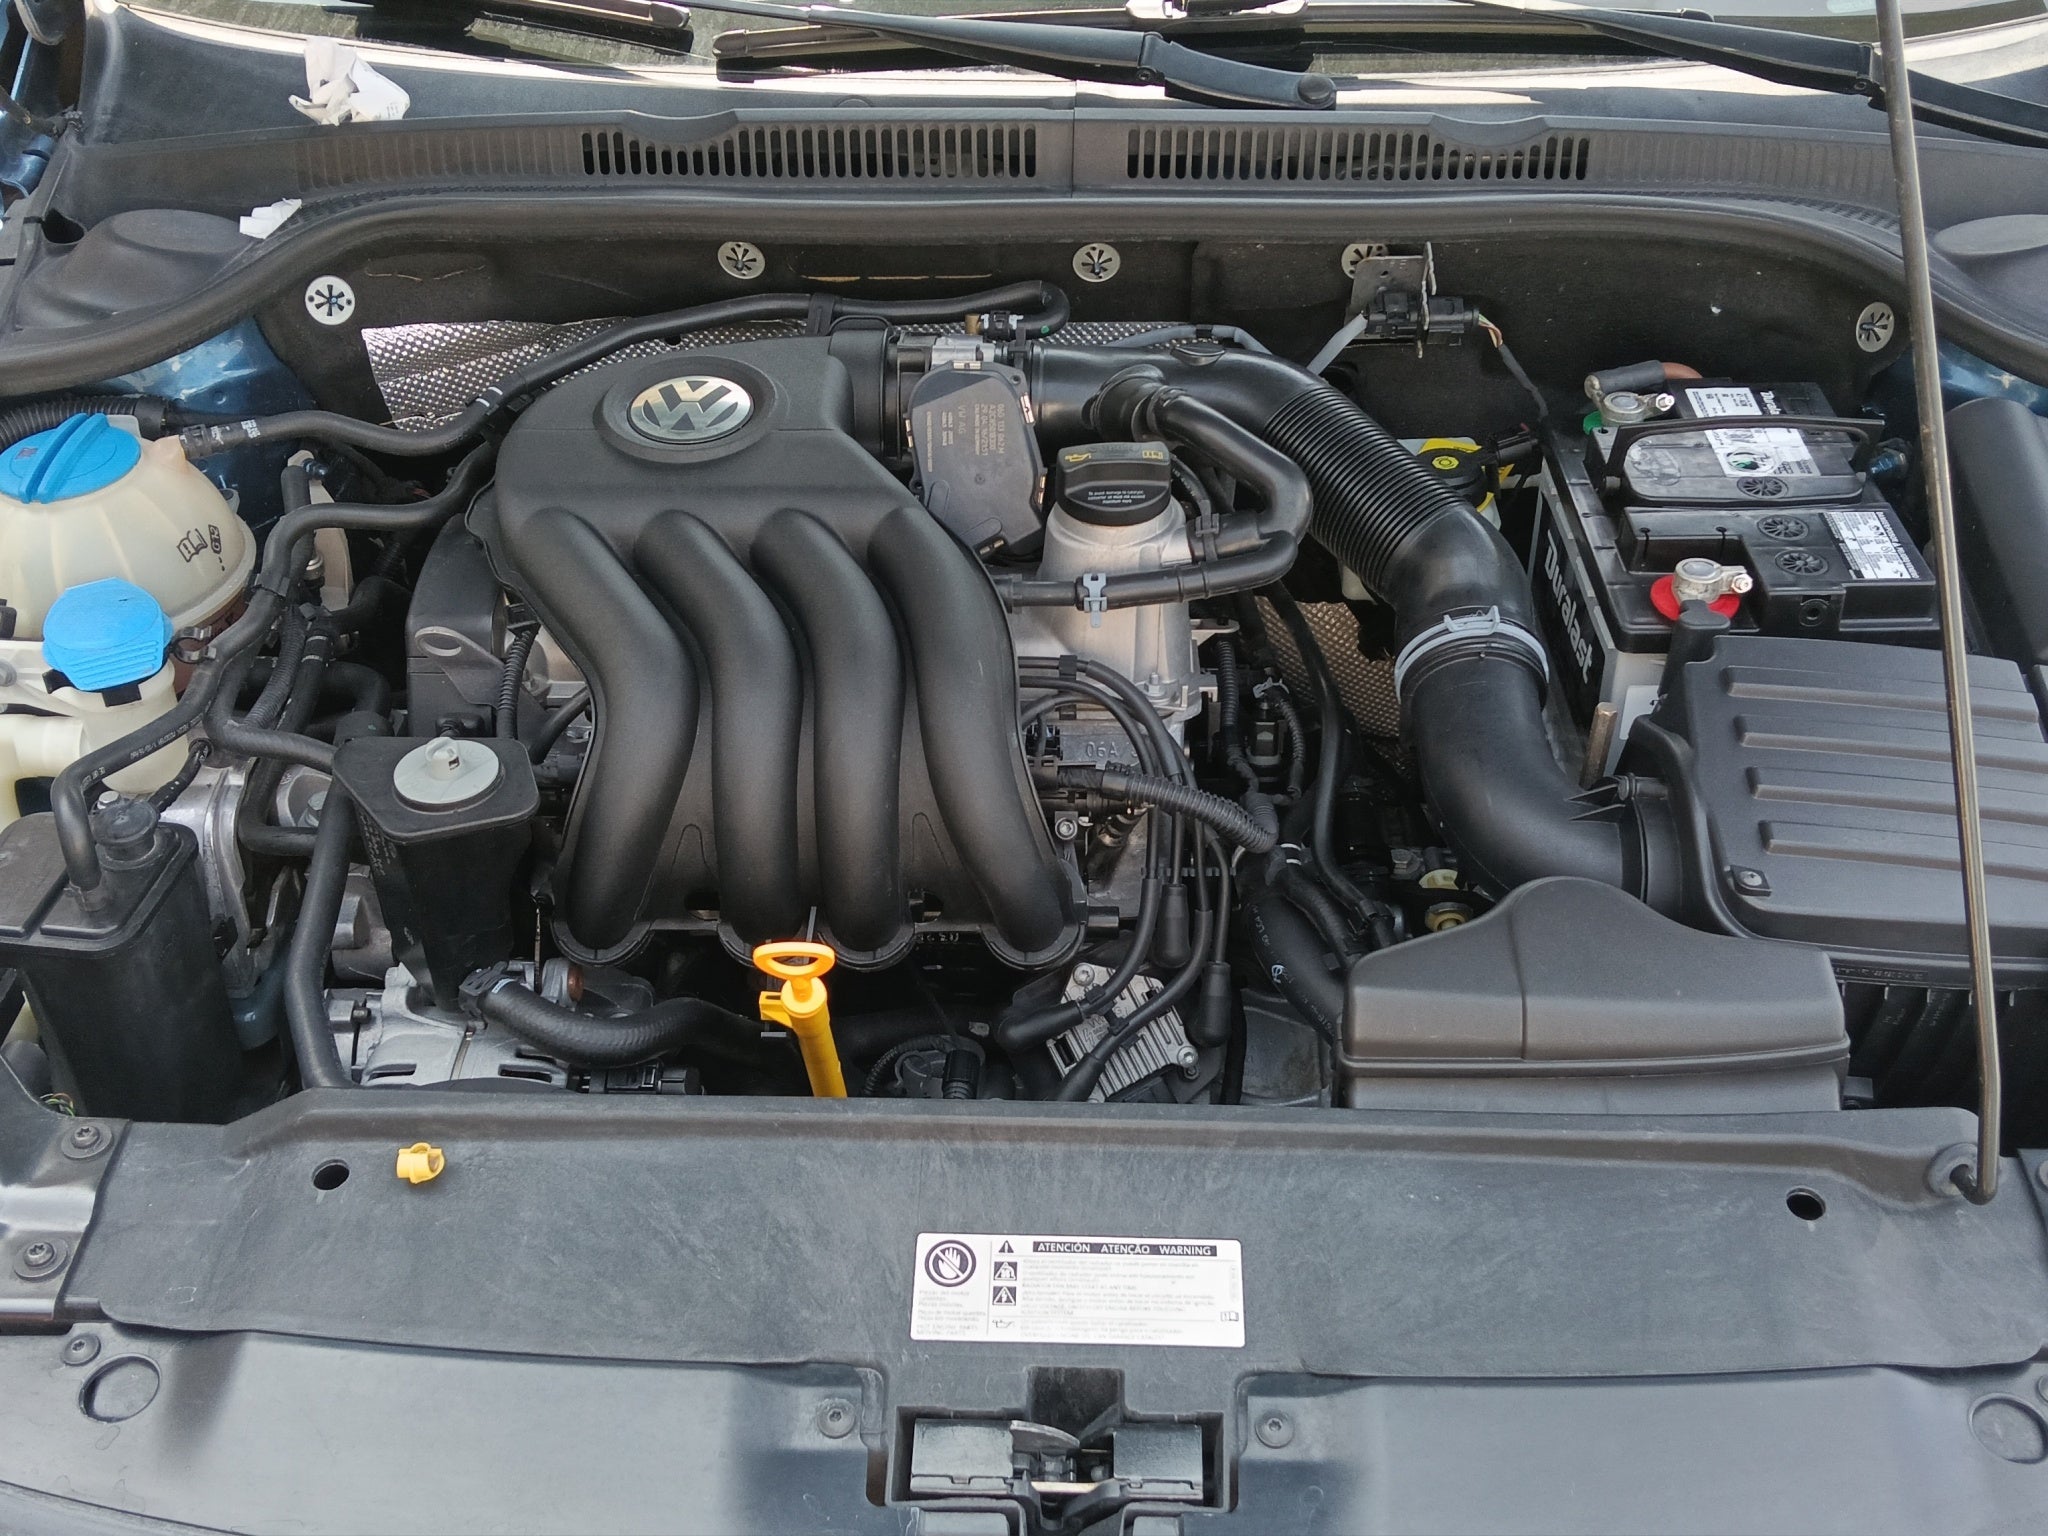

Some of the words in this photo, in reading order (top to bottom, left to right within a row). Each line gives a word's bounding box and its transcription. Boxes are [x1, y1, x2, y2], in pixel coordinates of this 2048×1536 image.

[631, 376, 751, 442] VW
[1760, 391, 1781, 415] Durala
[1545, 529, 1593, 685] Duralast
[1086, 741, 1119, 758] 06A
[1037, 1242, 1090, 1254] ATENCIÓN
[1159, 1245, 1212, 1256] WARNING
